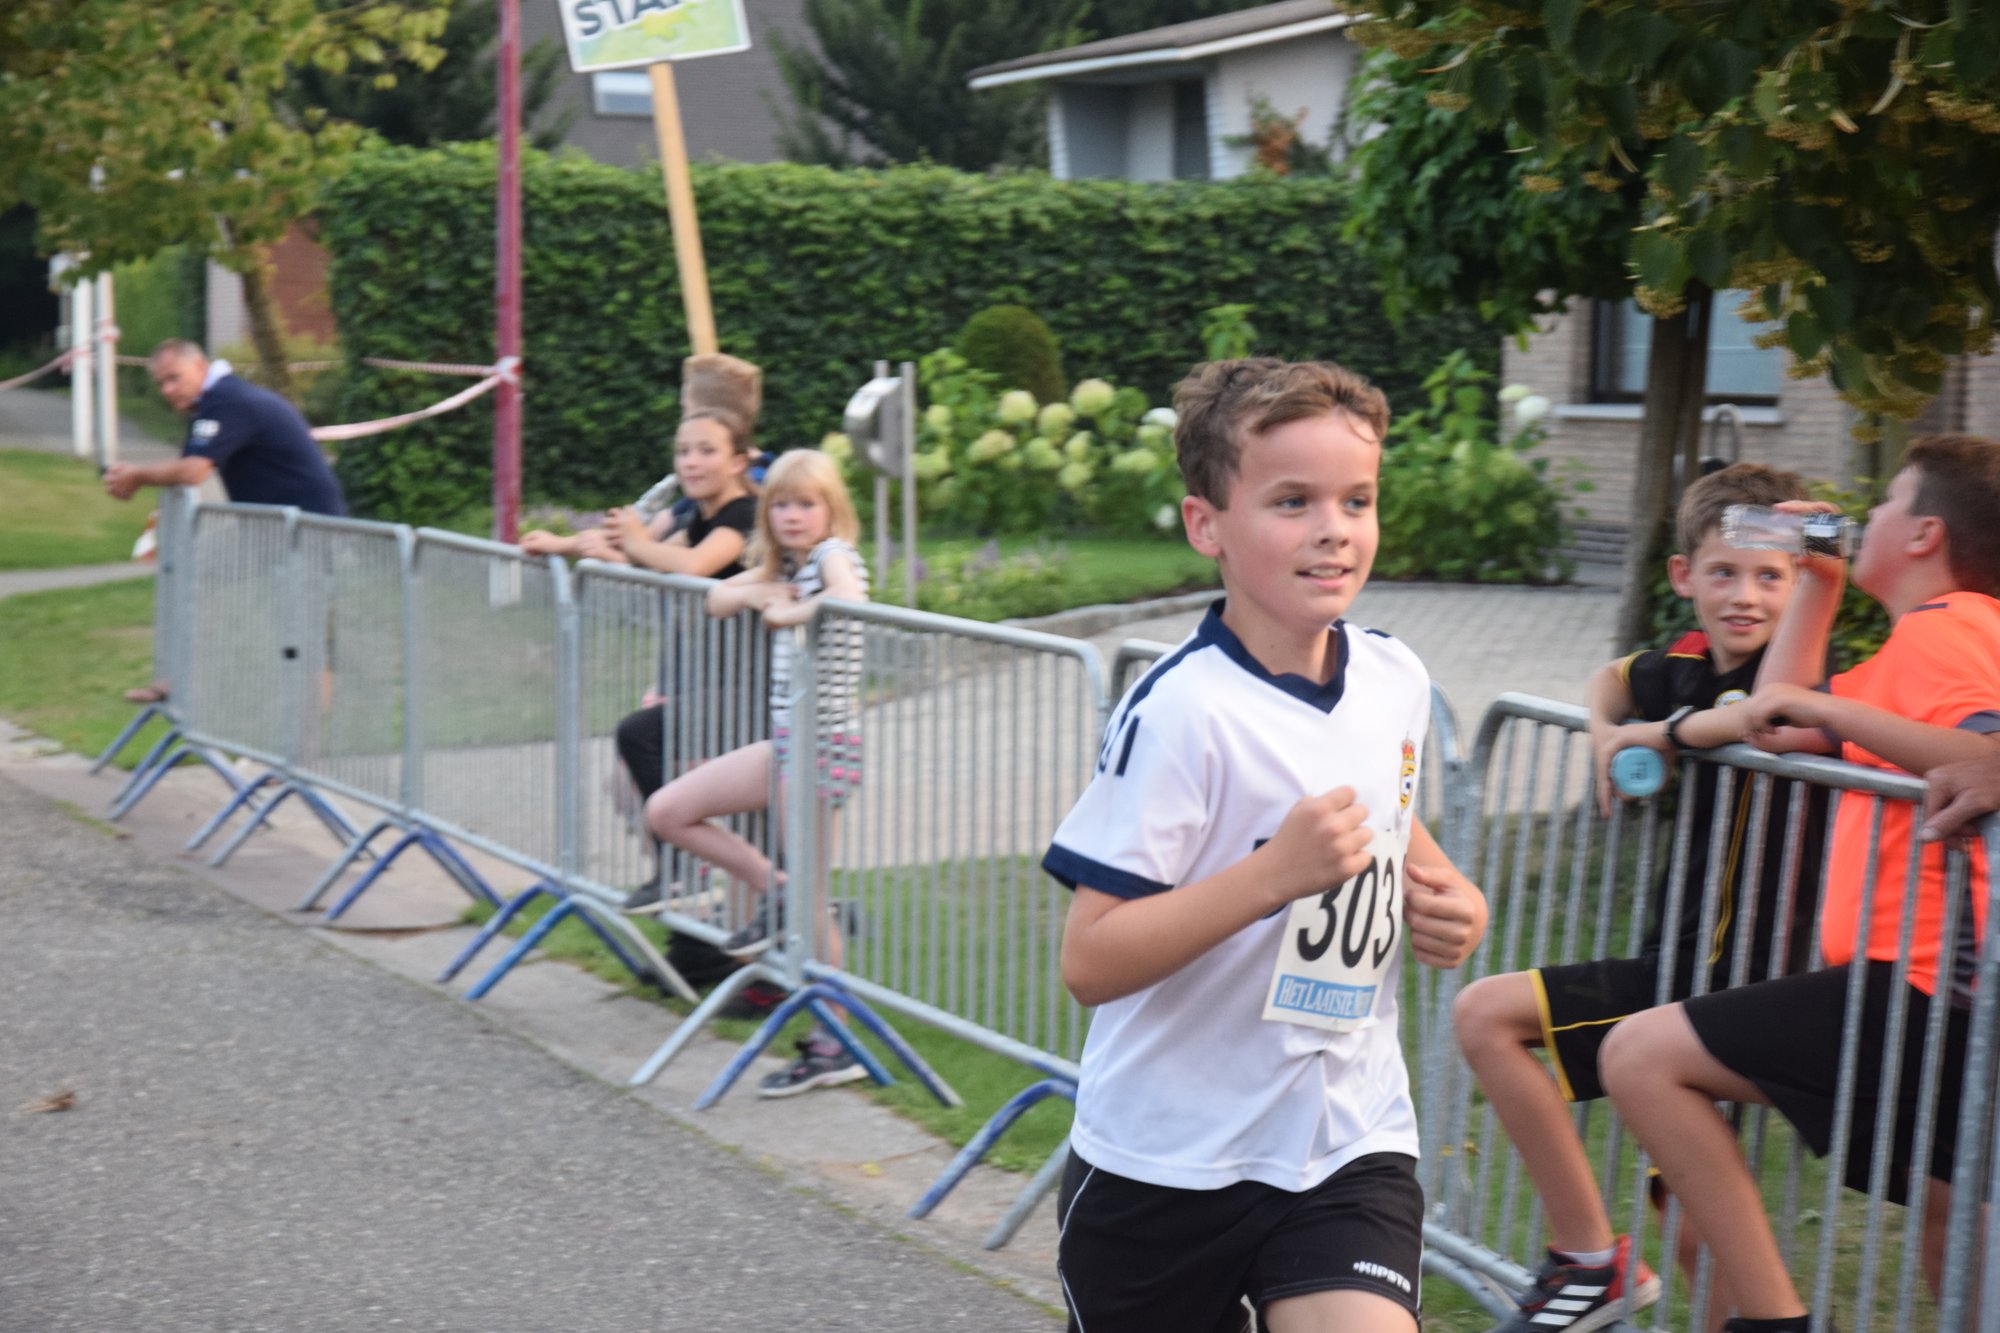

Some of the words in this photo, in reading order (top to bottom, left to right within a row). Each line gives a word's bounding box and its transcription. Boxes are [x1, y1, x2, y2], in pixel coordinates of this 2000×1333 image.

[574, 0, 680, 36] STA
[1297, 855, 1395, 969] 303
[1277, 977, 1308, 1008] HET
